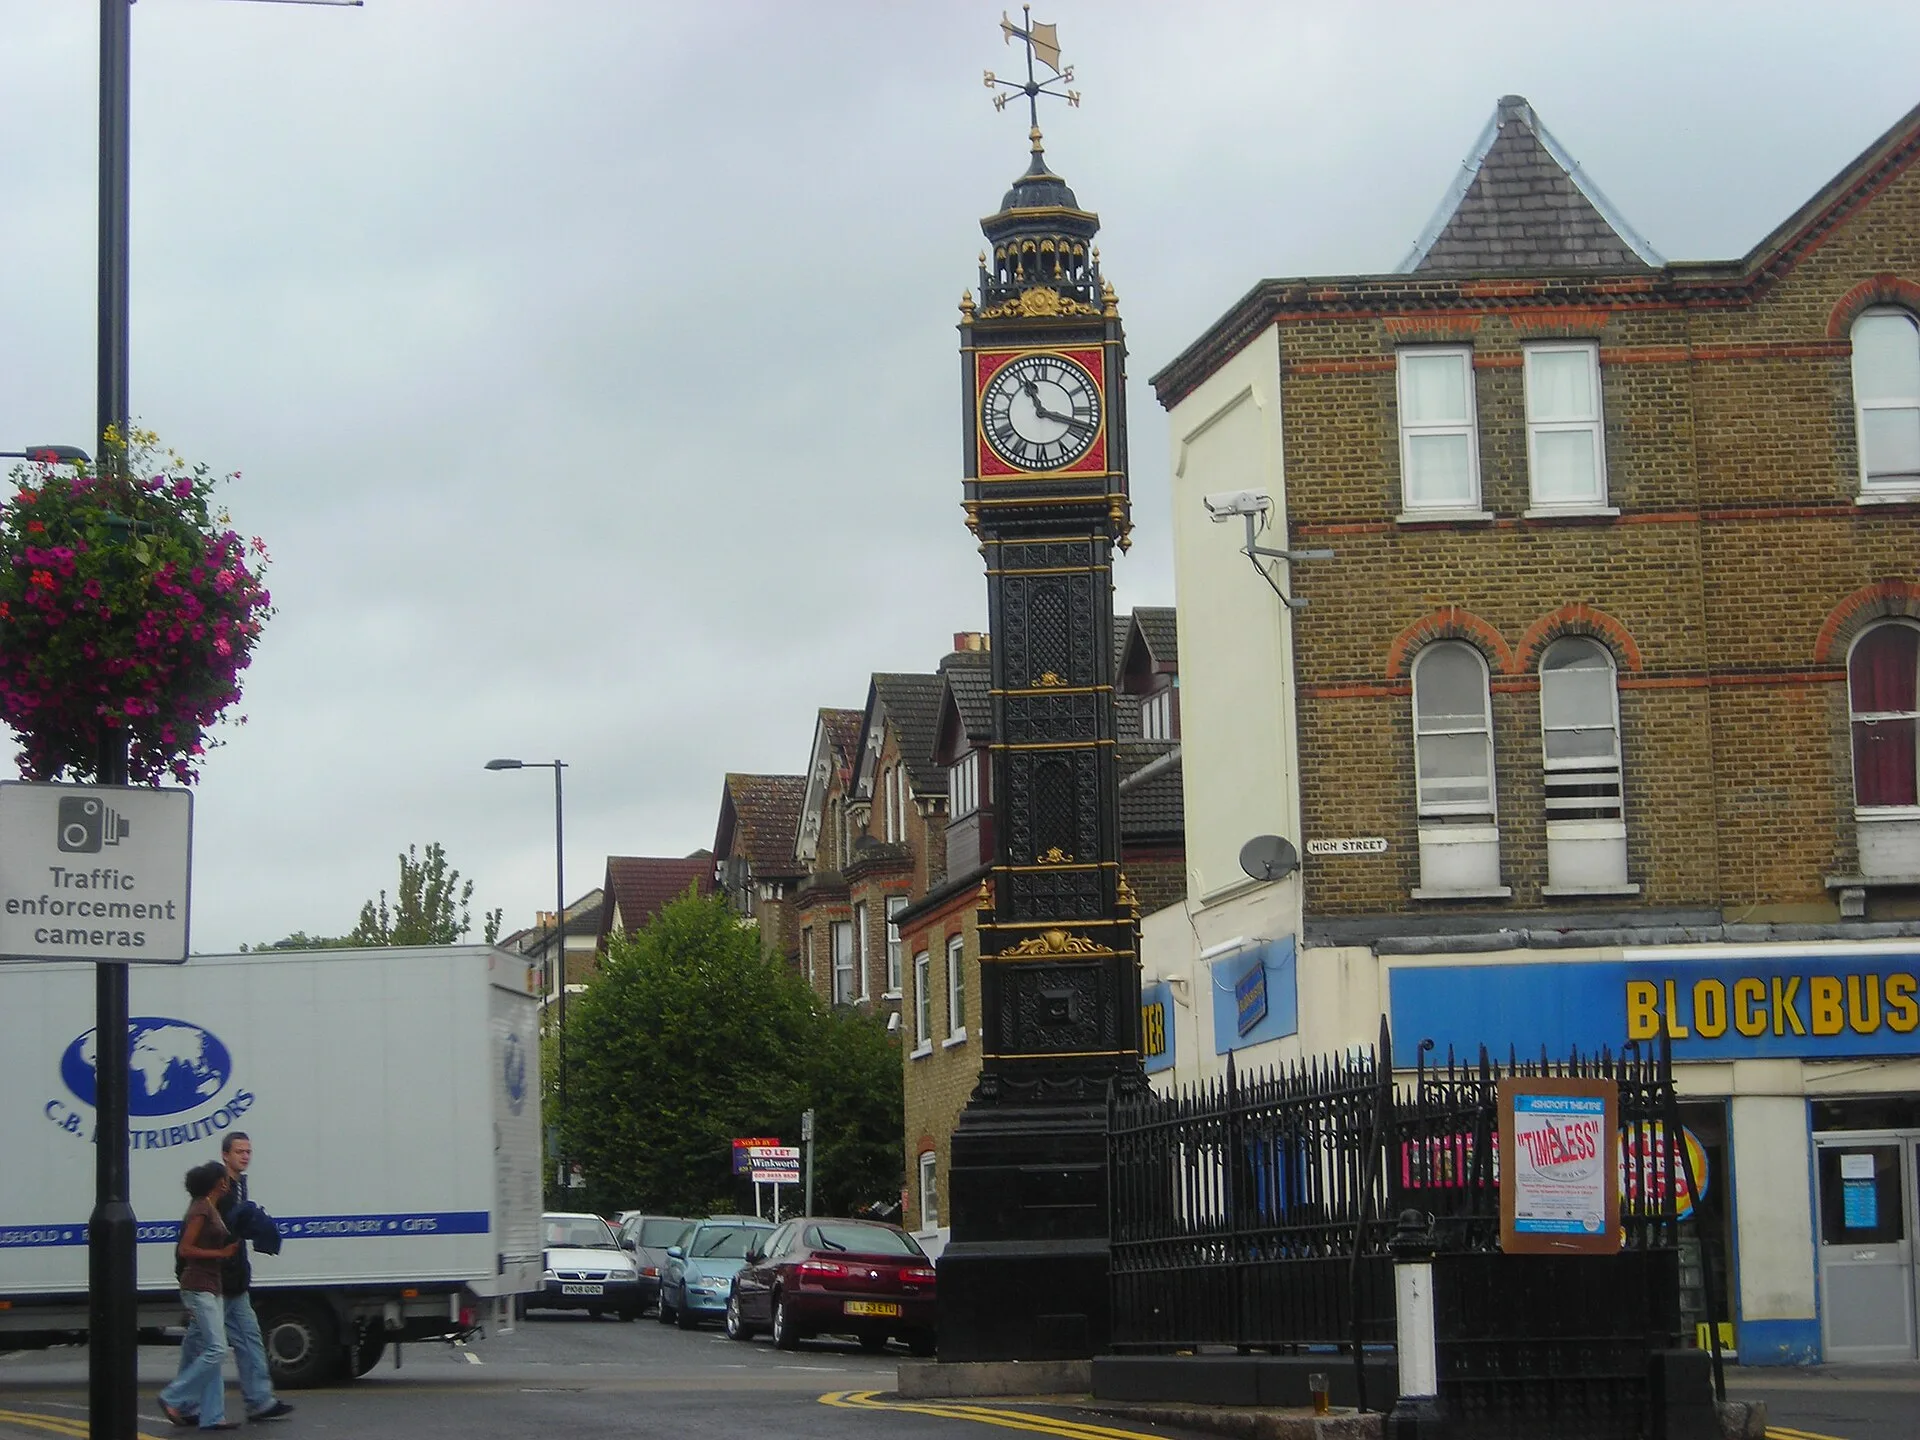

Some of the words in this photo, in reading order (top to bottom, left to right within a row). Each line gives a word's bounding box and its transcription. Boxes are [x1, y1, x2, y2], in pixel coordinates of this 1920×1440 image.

[1312, 841, 1337, 851] HIGH
[1342, 840, 1383, 851] STREET
[49, 866, 136, 891] Traffic
[5, 894, 176, 920] enforcement
[34, 927, 146, 947] cameras
[1626, 973, 1919, 1040] BLOCKBUS
[44, 1099, 84, 1138] C.B.
[91, 1087, 256, 1150] TRIBUTORS
[752, 1158, 800, 1169] Winkworth
[760, 1149, 772, 1157] TO
[775, 1149, 791, 1157] LET
[137, 1225, 177, 1239] OODS
[304, 1219, 384, 1234] STATIONERY
[401, 1218, 438, 1232] GIFTS
